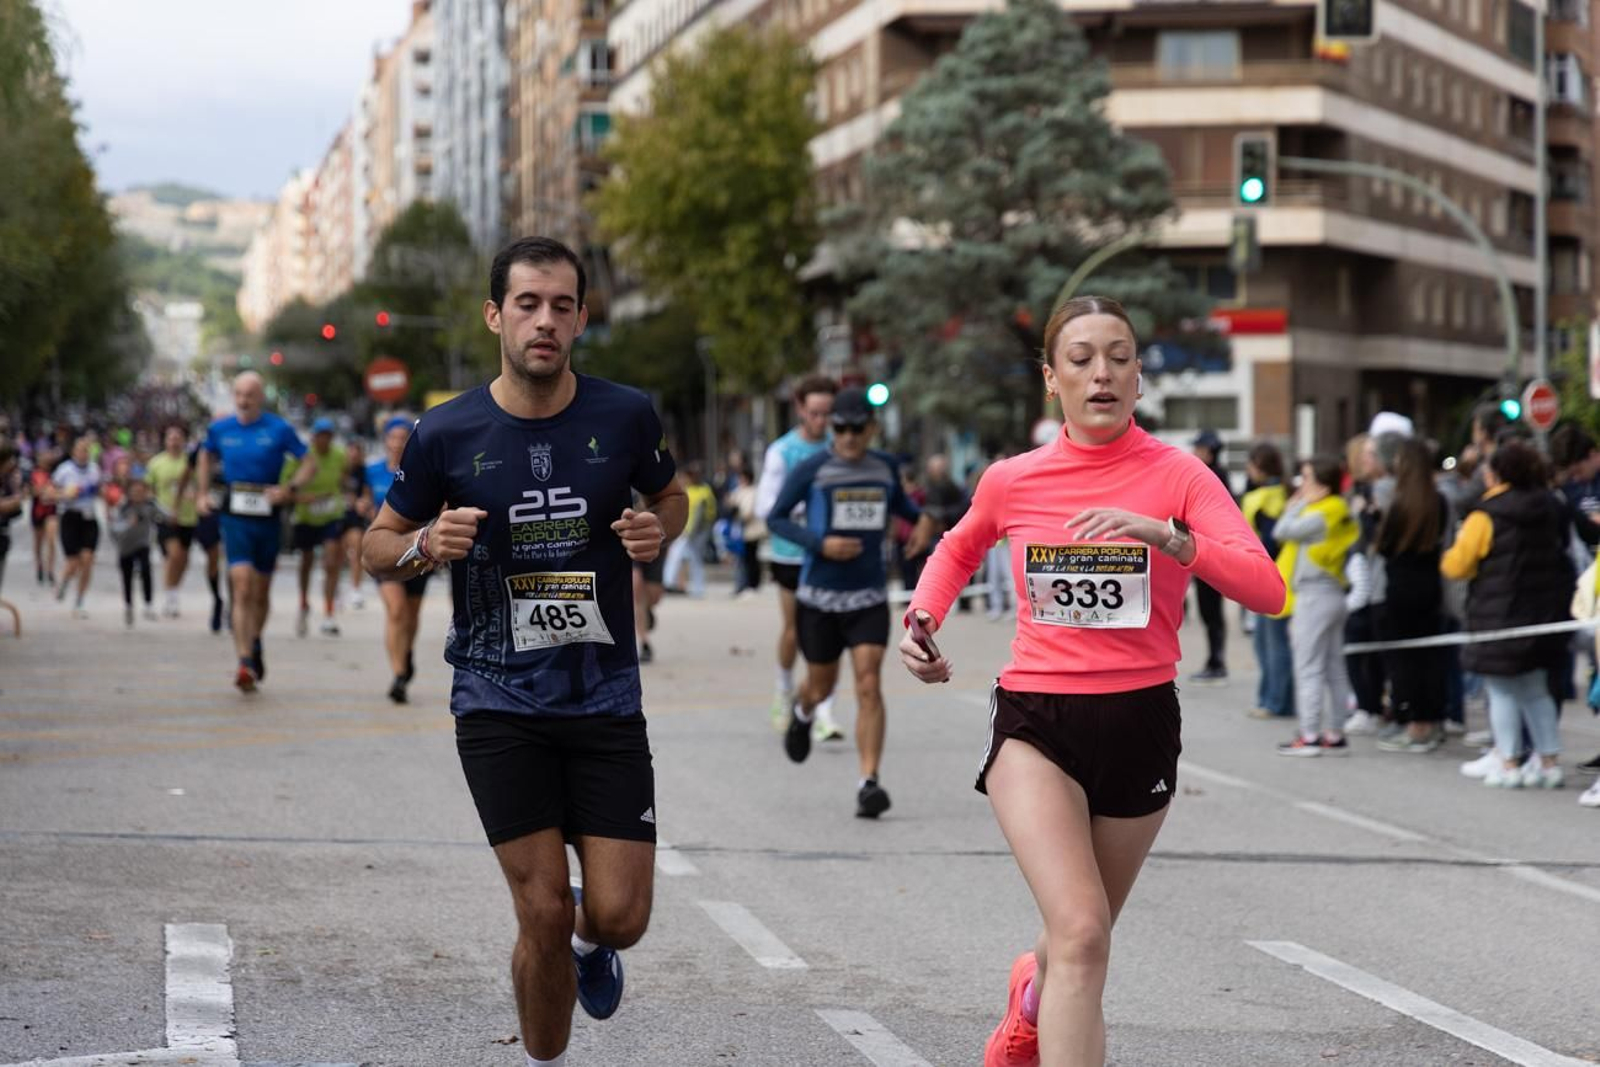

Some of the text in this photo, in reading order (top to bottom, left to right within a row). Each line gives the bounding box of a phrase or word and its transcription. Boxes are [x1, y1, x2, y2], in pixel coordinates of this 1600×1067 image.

[508, 486, 588, 524] 25
[510, 517, 590, 533] CARRERA
[511, 527, 592, 543] POPULAR
[521, 543, 545, 552] gran
[1030, 547, 1057, 563] XXV
[1058, 548, 1143, 556] CARRERA POPULAR
[1058, 554, 1144, 564] y gran caminata
[511, 576, 536, 591] XXV
[544, 583, 560, 591] gran
[560, 582, 591, 591] caminata
[1051, 579, 1124, 610] 333
[529, 604, 587, 631] 485
